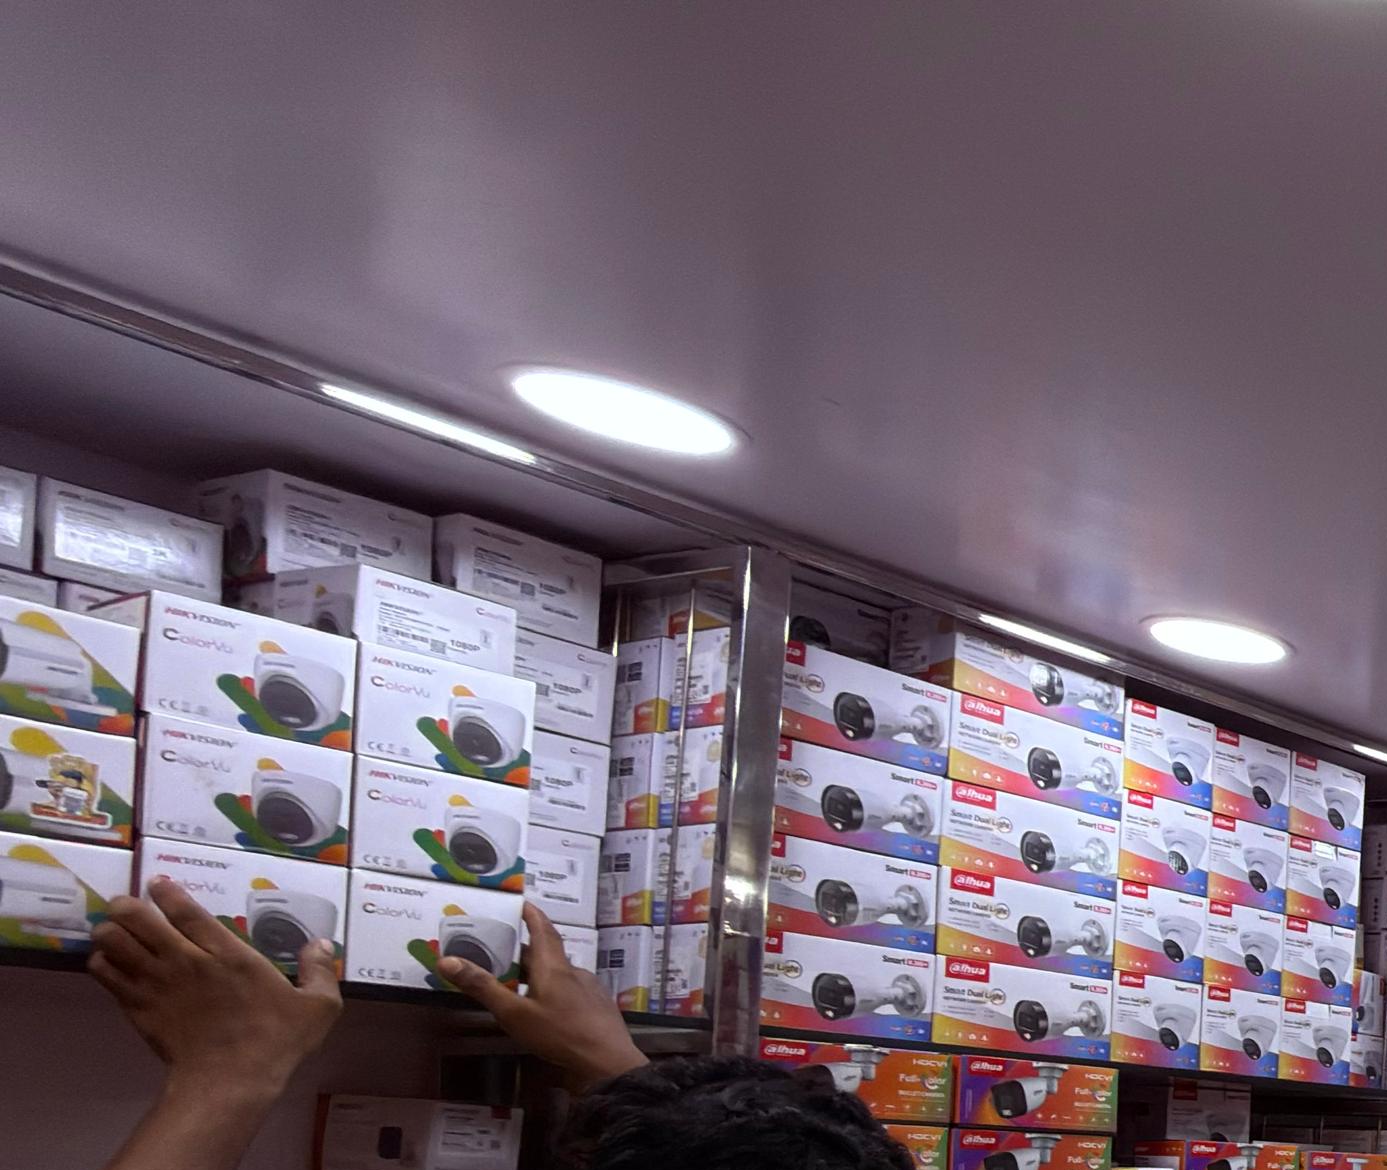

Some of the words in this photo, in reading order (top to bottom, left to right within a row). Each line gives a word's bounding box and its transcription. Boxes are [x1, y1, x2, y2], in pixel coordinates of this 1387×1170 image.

[164, 606, 240, 629] HIKVISION
[982, 727, 999, 739] Dual
[1084, 737, 1103, 749] Smart
[974, 815, 991, 826] Dual
[1078, 818, 1097, 830] Smart
[885, 864, 908, 876] Smart
[972, 902, 989, 911] Dual
[1074, 901, 1093, 911] Smart
[882, 955, 906, 965] Smart
[1070, 982, 1089, 992] Smart
